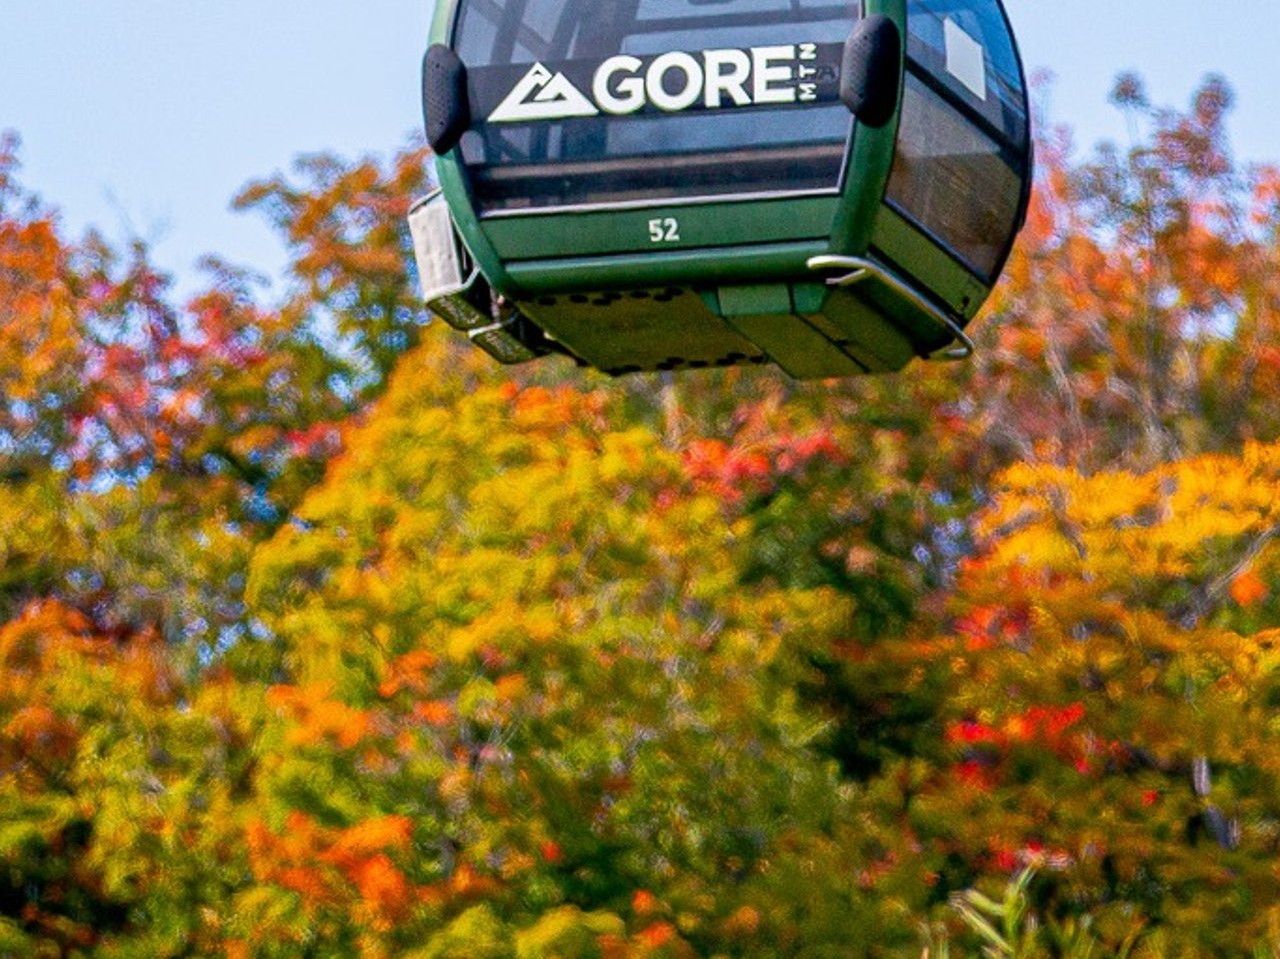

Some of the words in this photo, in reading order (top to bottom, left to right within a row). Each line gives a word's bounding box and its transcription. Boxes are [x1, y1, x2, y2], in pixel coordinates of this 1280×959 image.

[593, 45, 795, 114] GORE
[798, 43, 817, 101] MTN
[648, 218, 680, 242] 52
